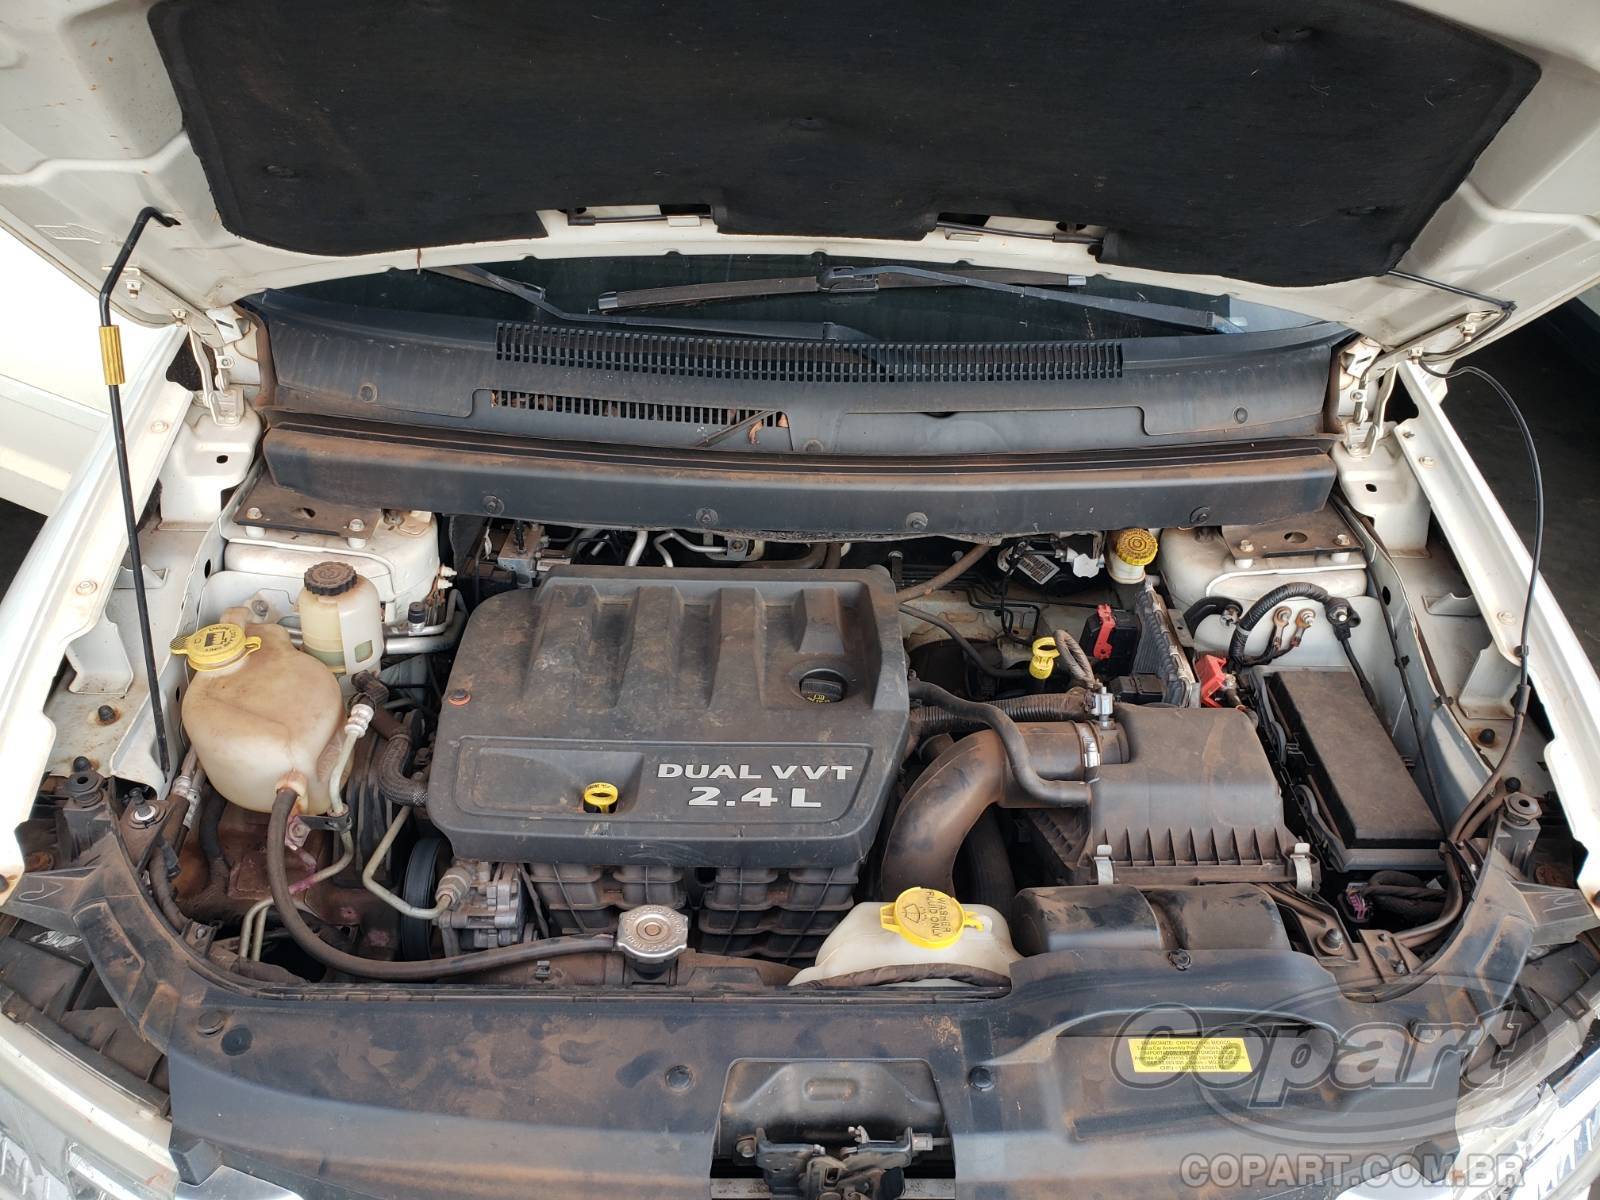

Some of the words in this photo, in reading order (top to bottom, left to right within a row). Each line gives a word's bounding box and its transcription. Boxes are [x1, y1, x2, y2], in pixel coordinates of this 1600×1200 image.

[657, 763, 762, 779] DUAL
[771, 765, 853, 780] VVT
[688, 786, 778, 807] 2.4
[790, 787, 822, 808] L
[927, 891, 938, 914] FLUID
[937, 897, 951, 932] WASHER
[930, 916, 942, 937] ONLY
